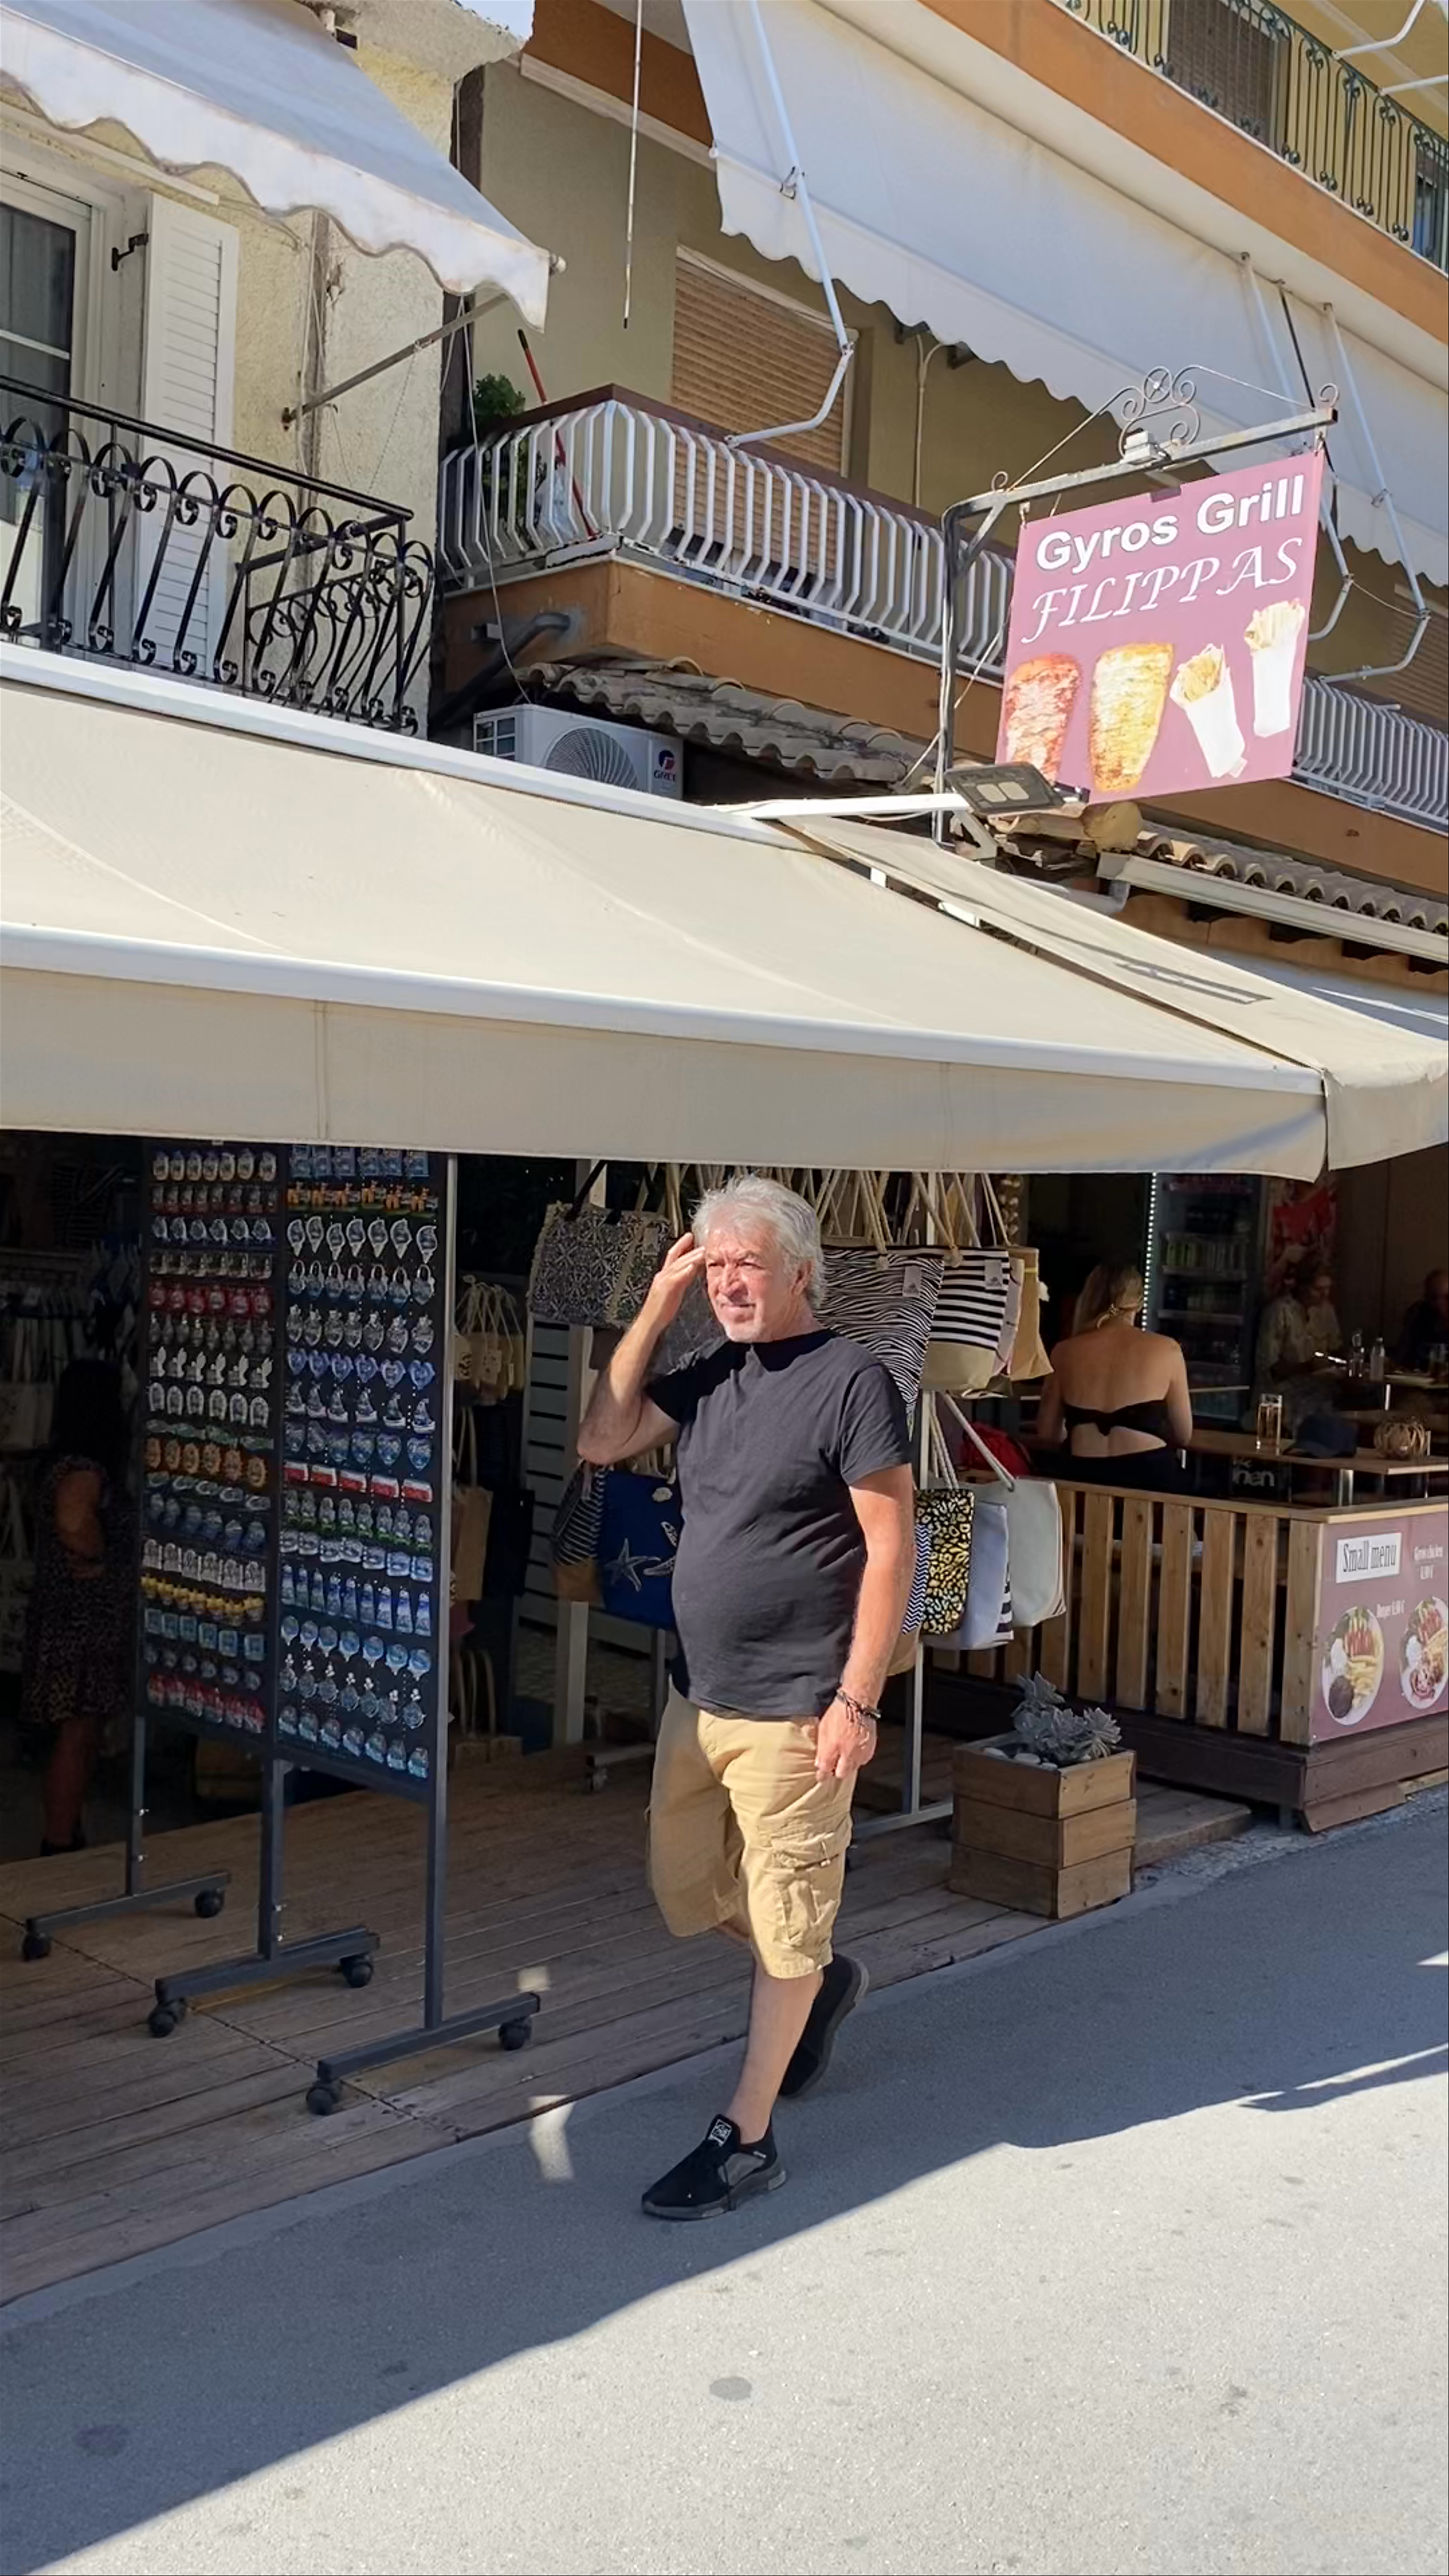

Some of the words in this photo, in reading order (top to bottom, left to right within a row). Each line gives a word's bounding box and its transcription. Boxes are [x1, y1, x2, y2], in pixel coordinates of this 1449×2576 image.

[1037, 514, 1179, 574] Gyros
[1197, 474, 1304, 534] Grill
[1020, 537, 1303, 644] FILIPPAS
[1343, 1540, 1369, 1572] Small
[1371, 1545, 1397, 1569] menu
